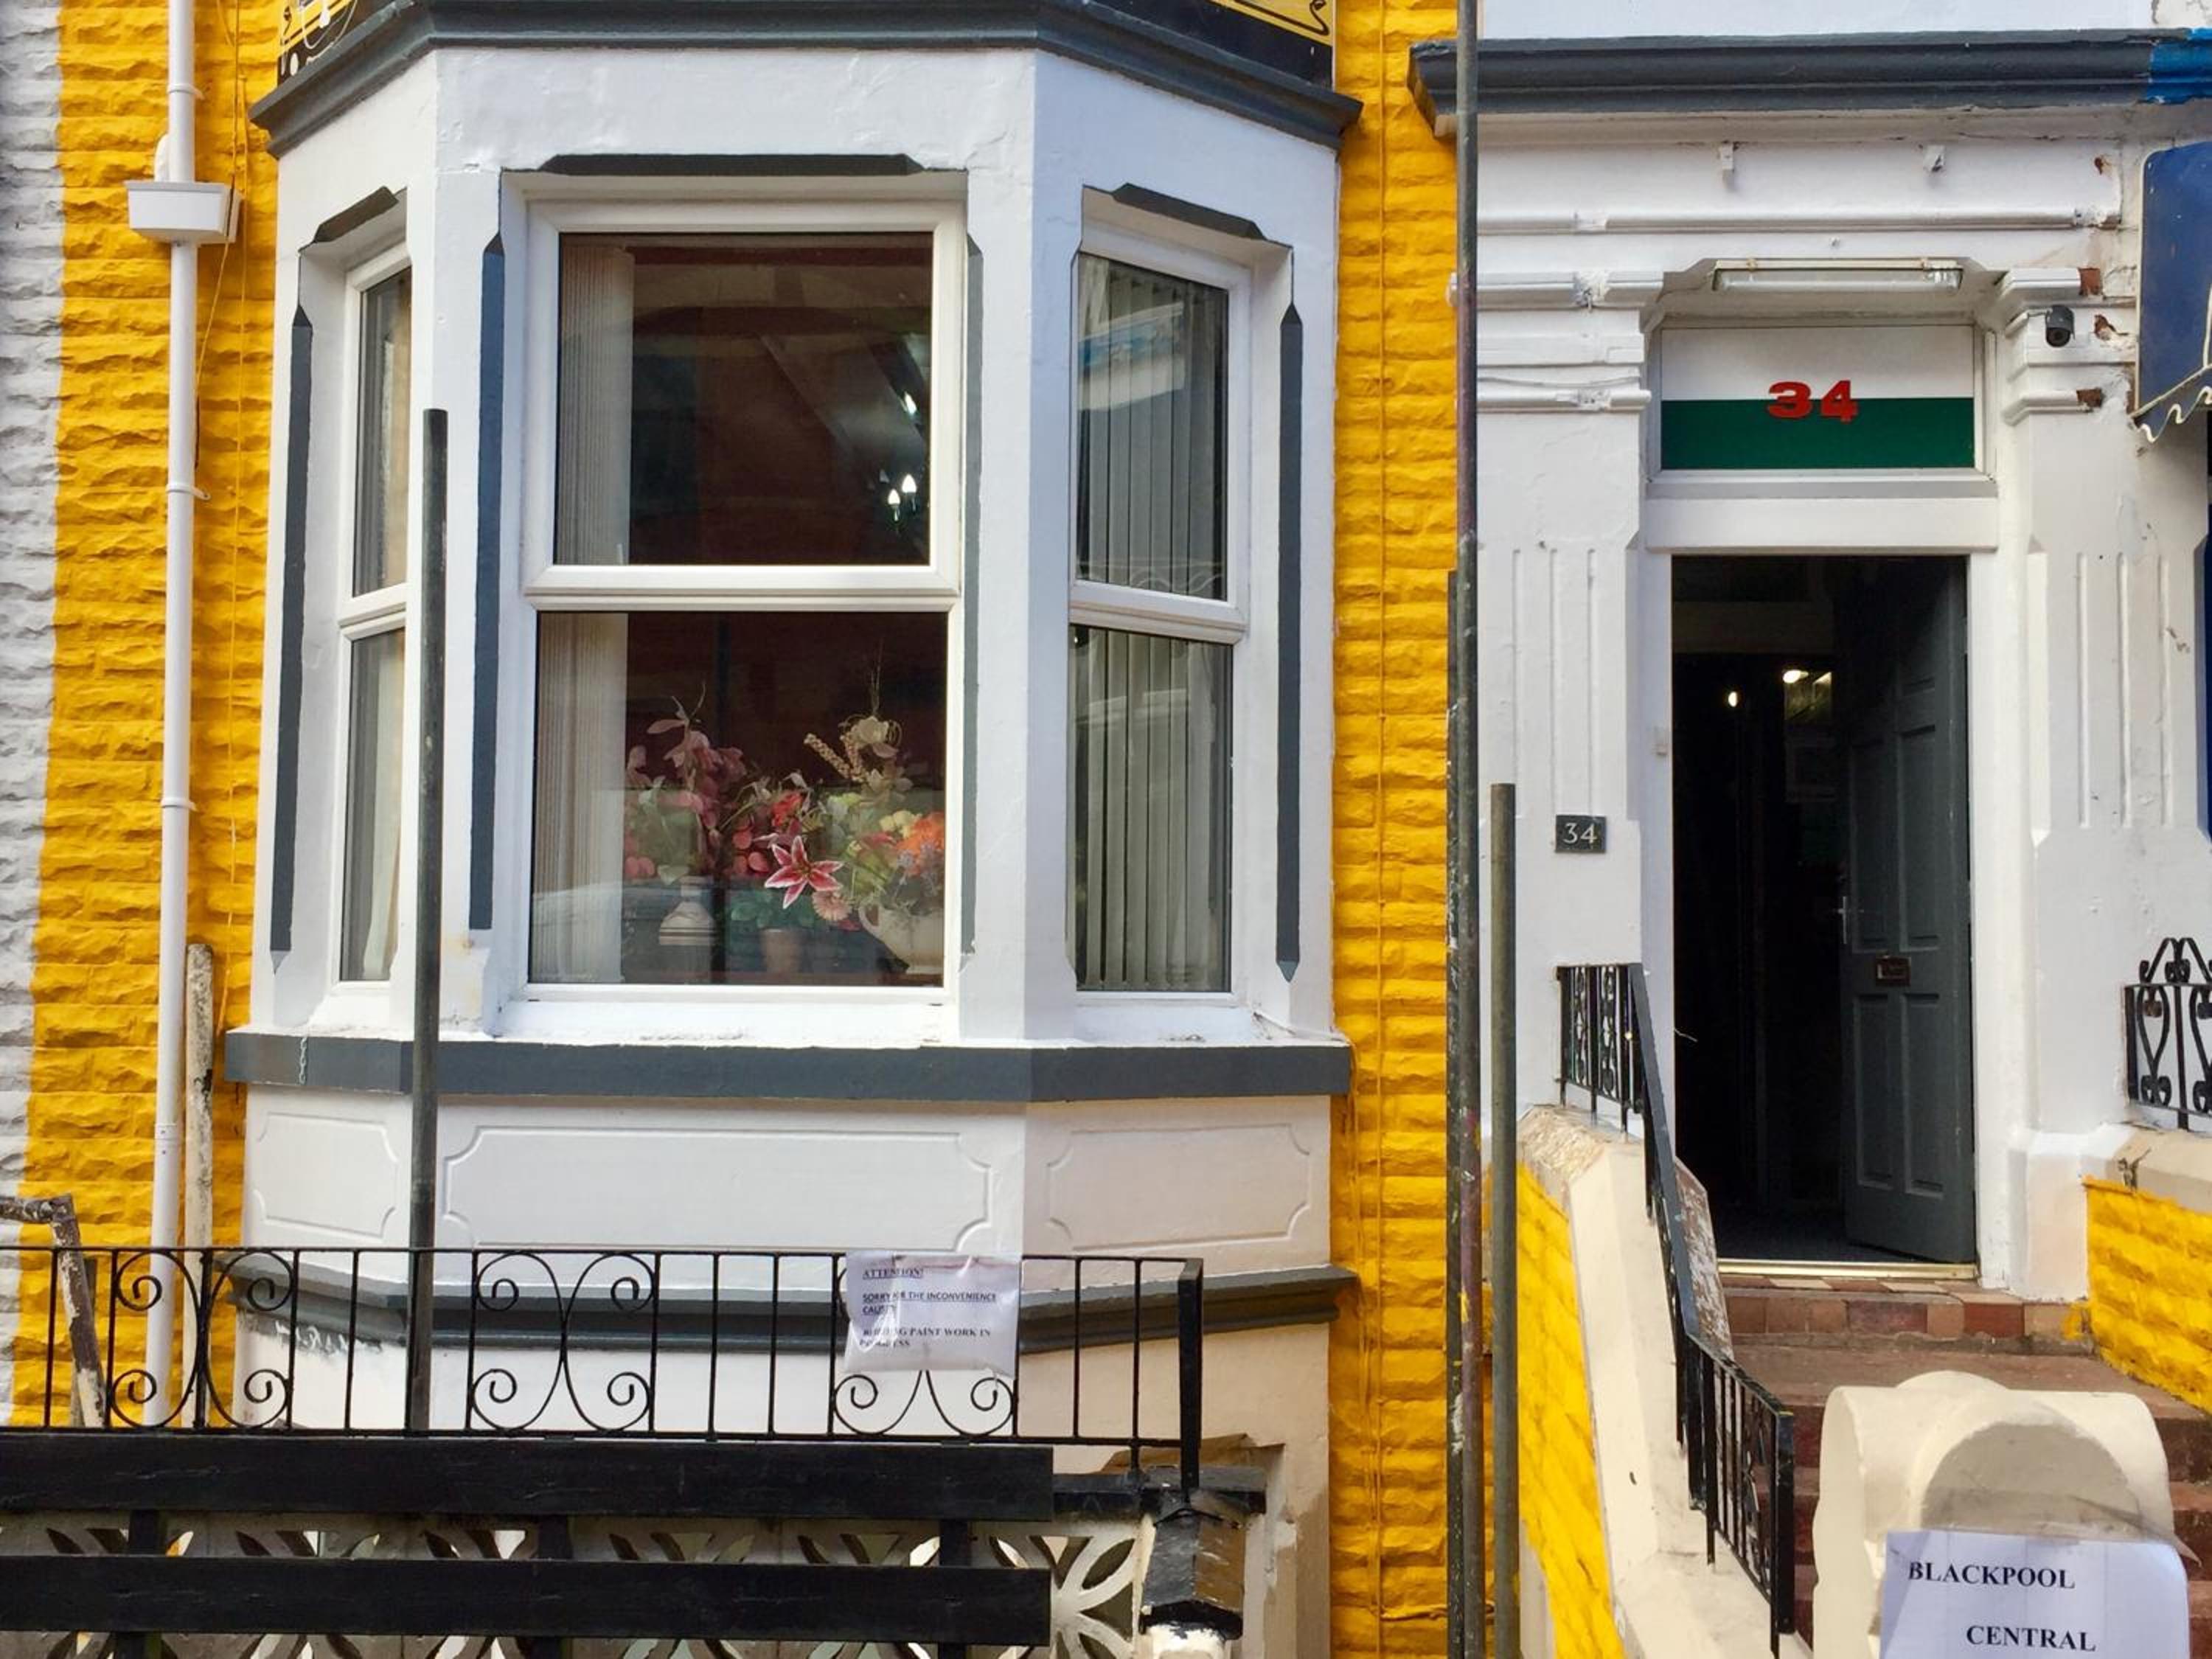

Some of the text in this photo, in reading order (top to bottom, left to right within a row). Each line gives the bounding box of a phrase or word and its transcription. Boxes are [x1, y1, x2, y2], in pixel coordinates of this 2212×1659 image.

[1767, 380, 1859, 422] 34
[1563, 822, 1598, 844] 34
[863, 1293, 891, 1303] SORRY
[908, 1292, 924, 1301] THE
[927, 1292, 996, 1303] INCONVENIENCE
[909, 1326, 940, 1336] PAINT
[944, 1327, 976, 1337] WORK
[980, 1328, 991, 1337] IN
[1908, 1560, 2076, 1589] BLACKPOOL
[1966, 1625, 2096, 1652] CENTRAL
